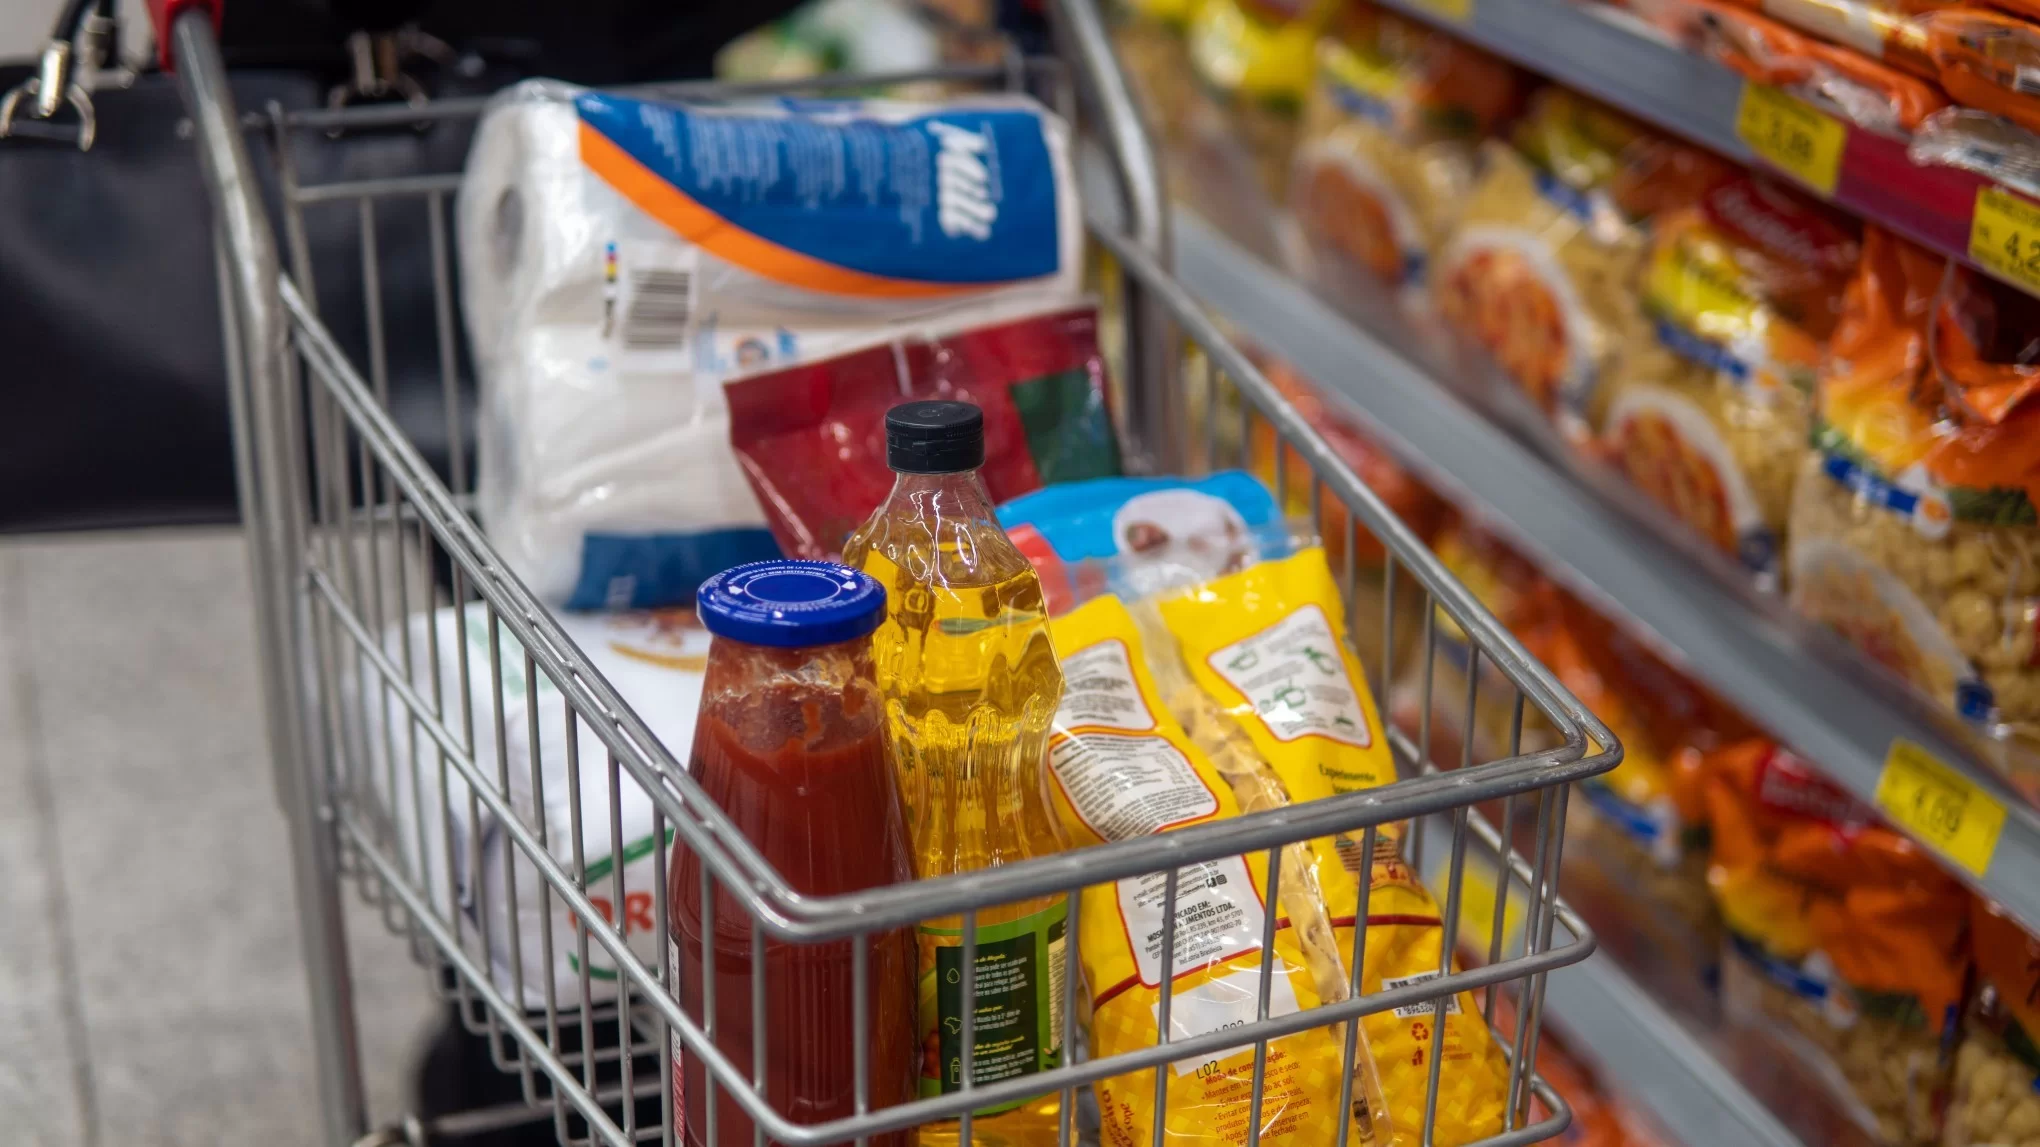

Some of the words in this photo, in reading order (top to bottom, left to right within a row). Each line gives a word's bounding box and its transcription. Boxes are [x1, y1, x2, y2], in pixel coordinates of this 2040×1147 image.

[1197, 900, 1212, 911] EM:
[1215, 902, 1236, 914] LTDA.
[1196, 1060, 1221, 1079] L02
[1228, 1066, 1239, 1076] de
[1239, 1051, 1287, 1074] consação:
[1218, 1108, 1237, 1120] Evitar
[1215, 1118, 1246, 1133] produtos
